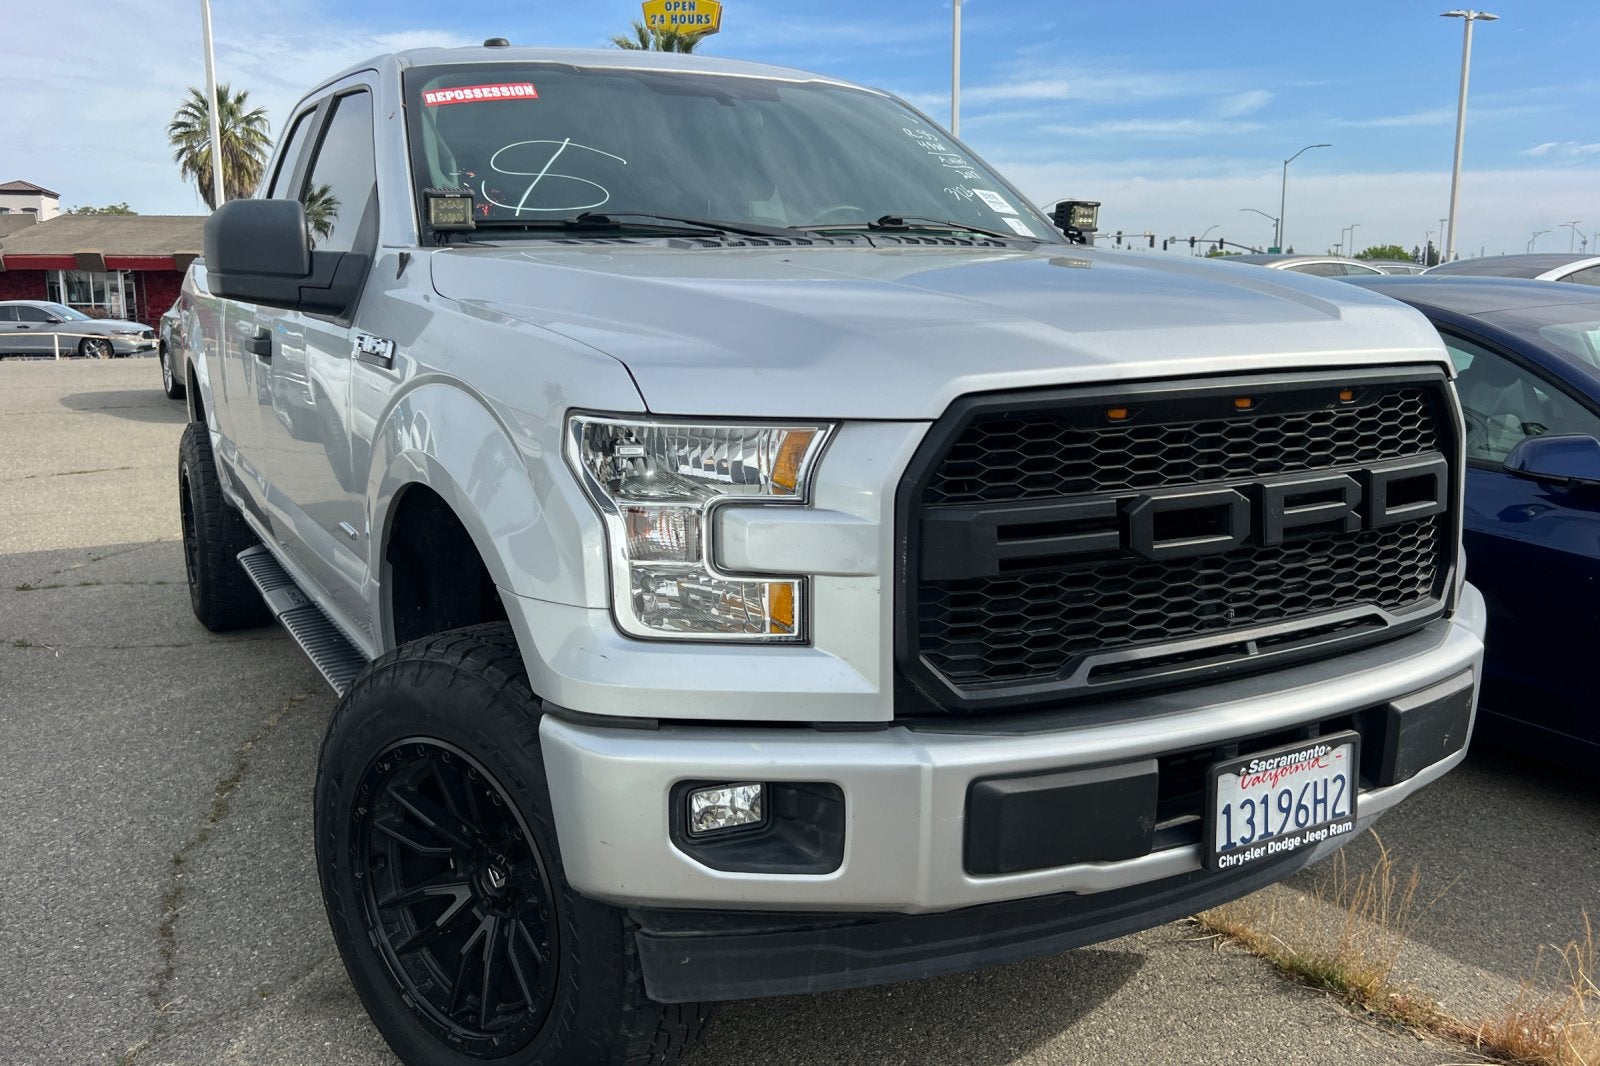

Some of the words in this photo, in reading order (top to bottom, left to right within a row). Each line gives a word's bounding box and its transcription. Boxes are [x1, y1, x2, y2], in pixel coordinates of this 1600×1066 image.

[651, 15, 665, 24] 24
[671, 14, 711, 24] HOURS
[665, 1, 696, 11] OPEN
[425, 85, 535, 104] REPOSSESSION
[920, 452, 1448, 581] FORD
[1241, 757, 1329, 790] California
[1248, 744, 1326, 774] Sacramento
[1220, 774, 1346, 852] 13196H2
[1218, 846, 1266, 868] Chrysler
[1268, 836, 1301, 854] Dodge
[1303, 828, 1328, 845] Jeep
[1329, 821, 1353, 837] Ram
